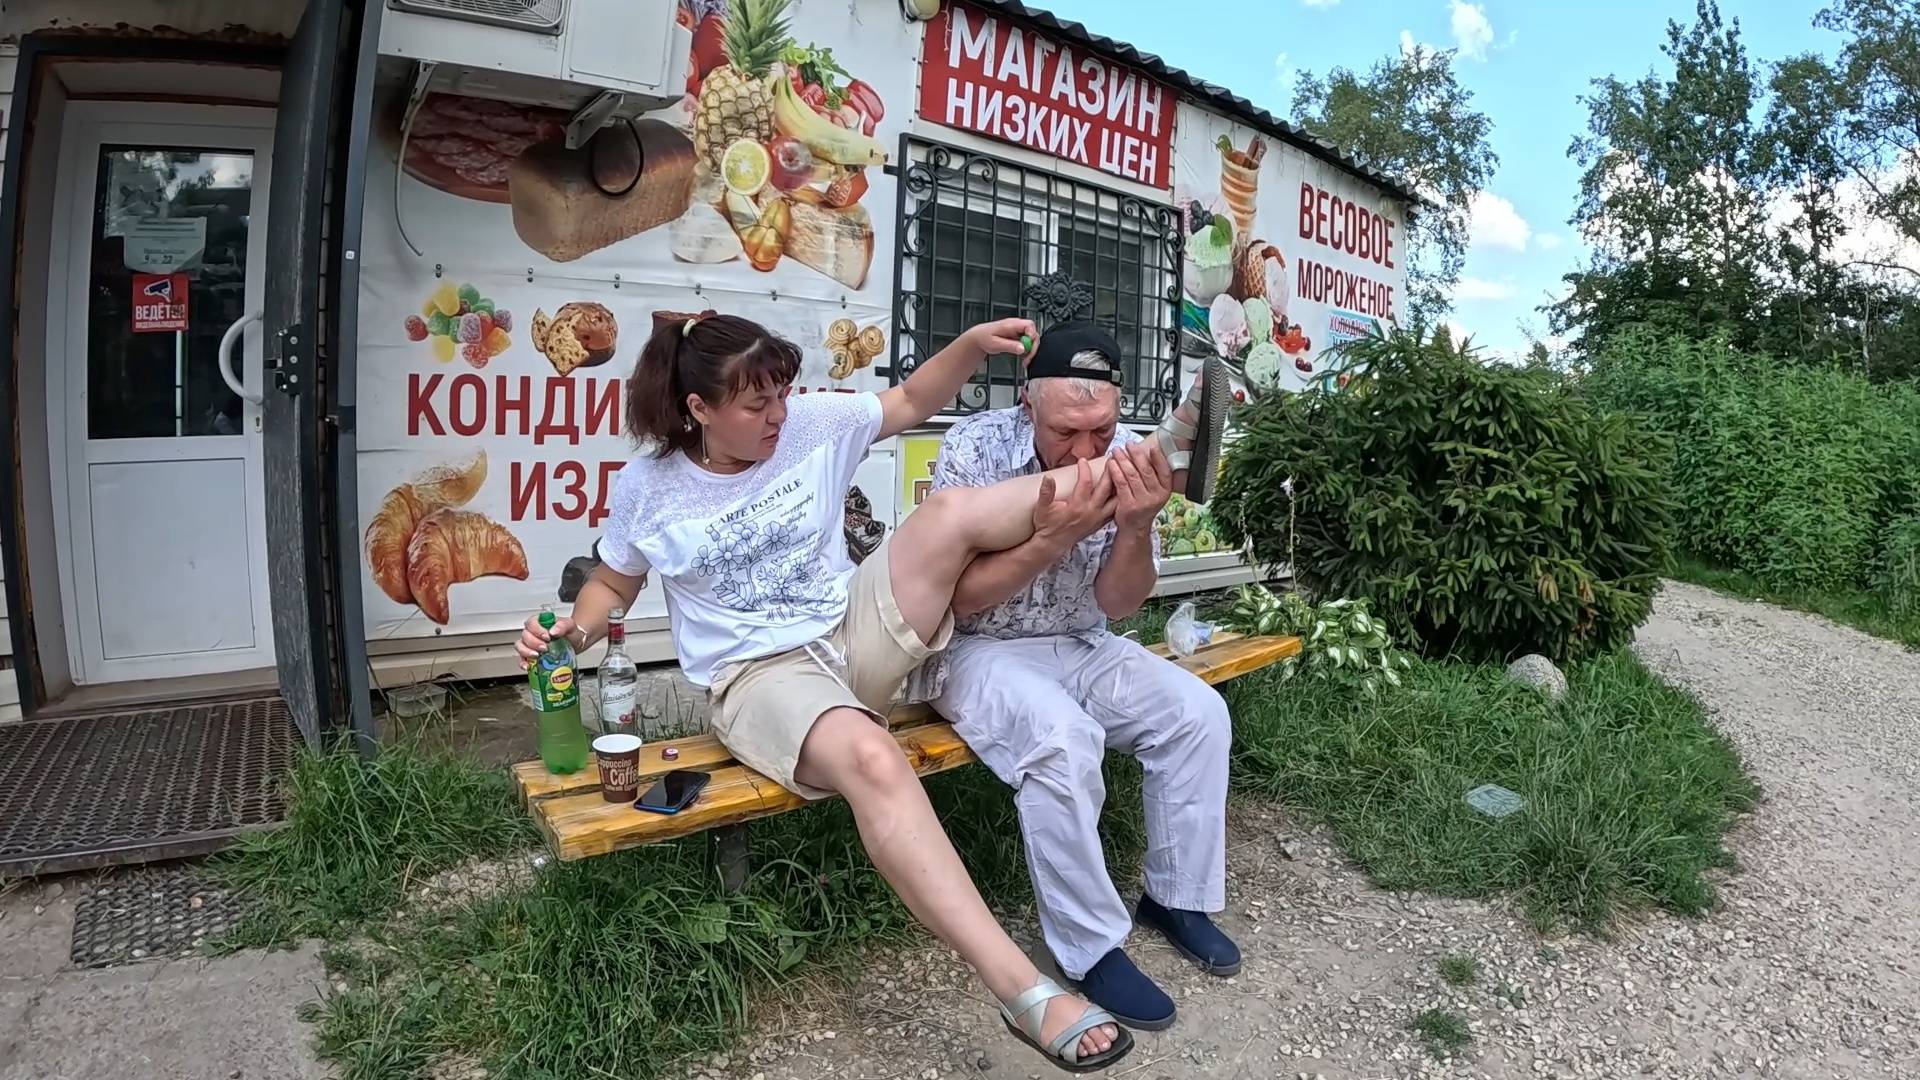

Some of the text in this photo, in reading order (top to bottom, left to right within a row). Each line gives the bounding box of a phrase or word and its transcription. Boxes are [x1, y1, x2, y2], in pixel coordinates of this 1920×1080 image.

[948, 7, 1162, 137] МАГАЗИН
[946, 77, 1158, 185] НИЗКИХ ЦЕН
[1299, 181, 1395, 269] ВЕСОВОЕ
[1297, 258, 1395, 321] МОРОЖЕНОЕ
[750, 479, 803, 512] POSTALE
